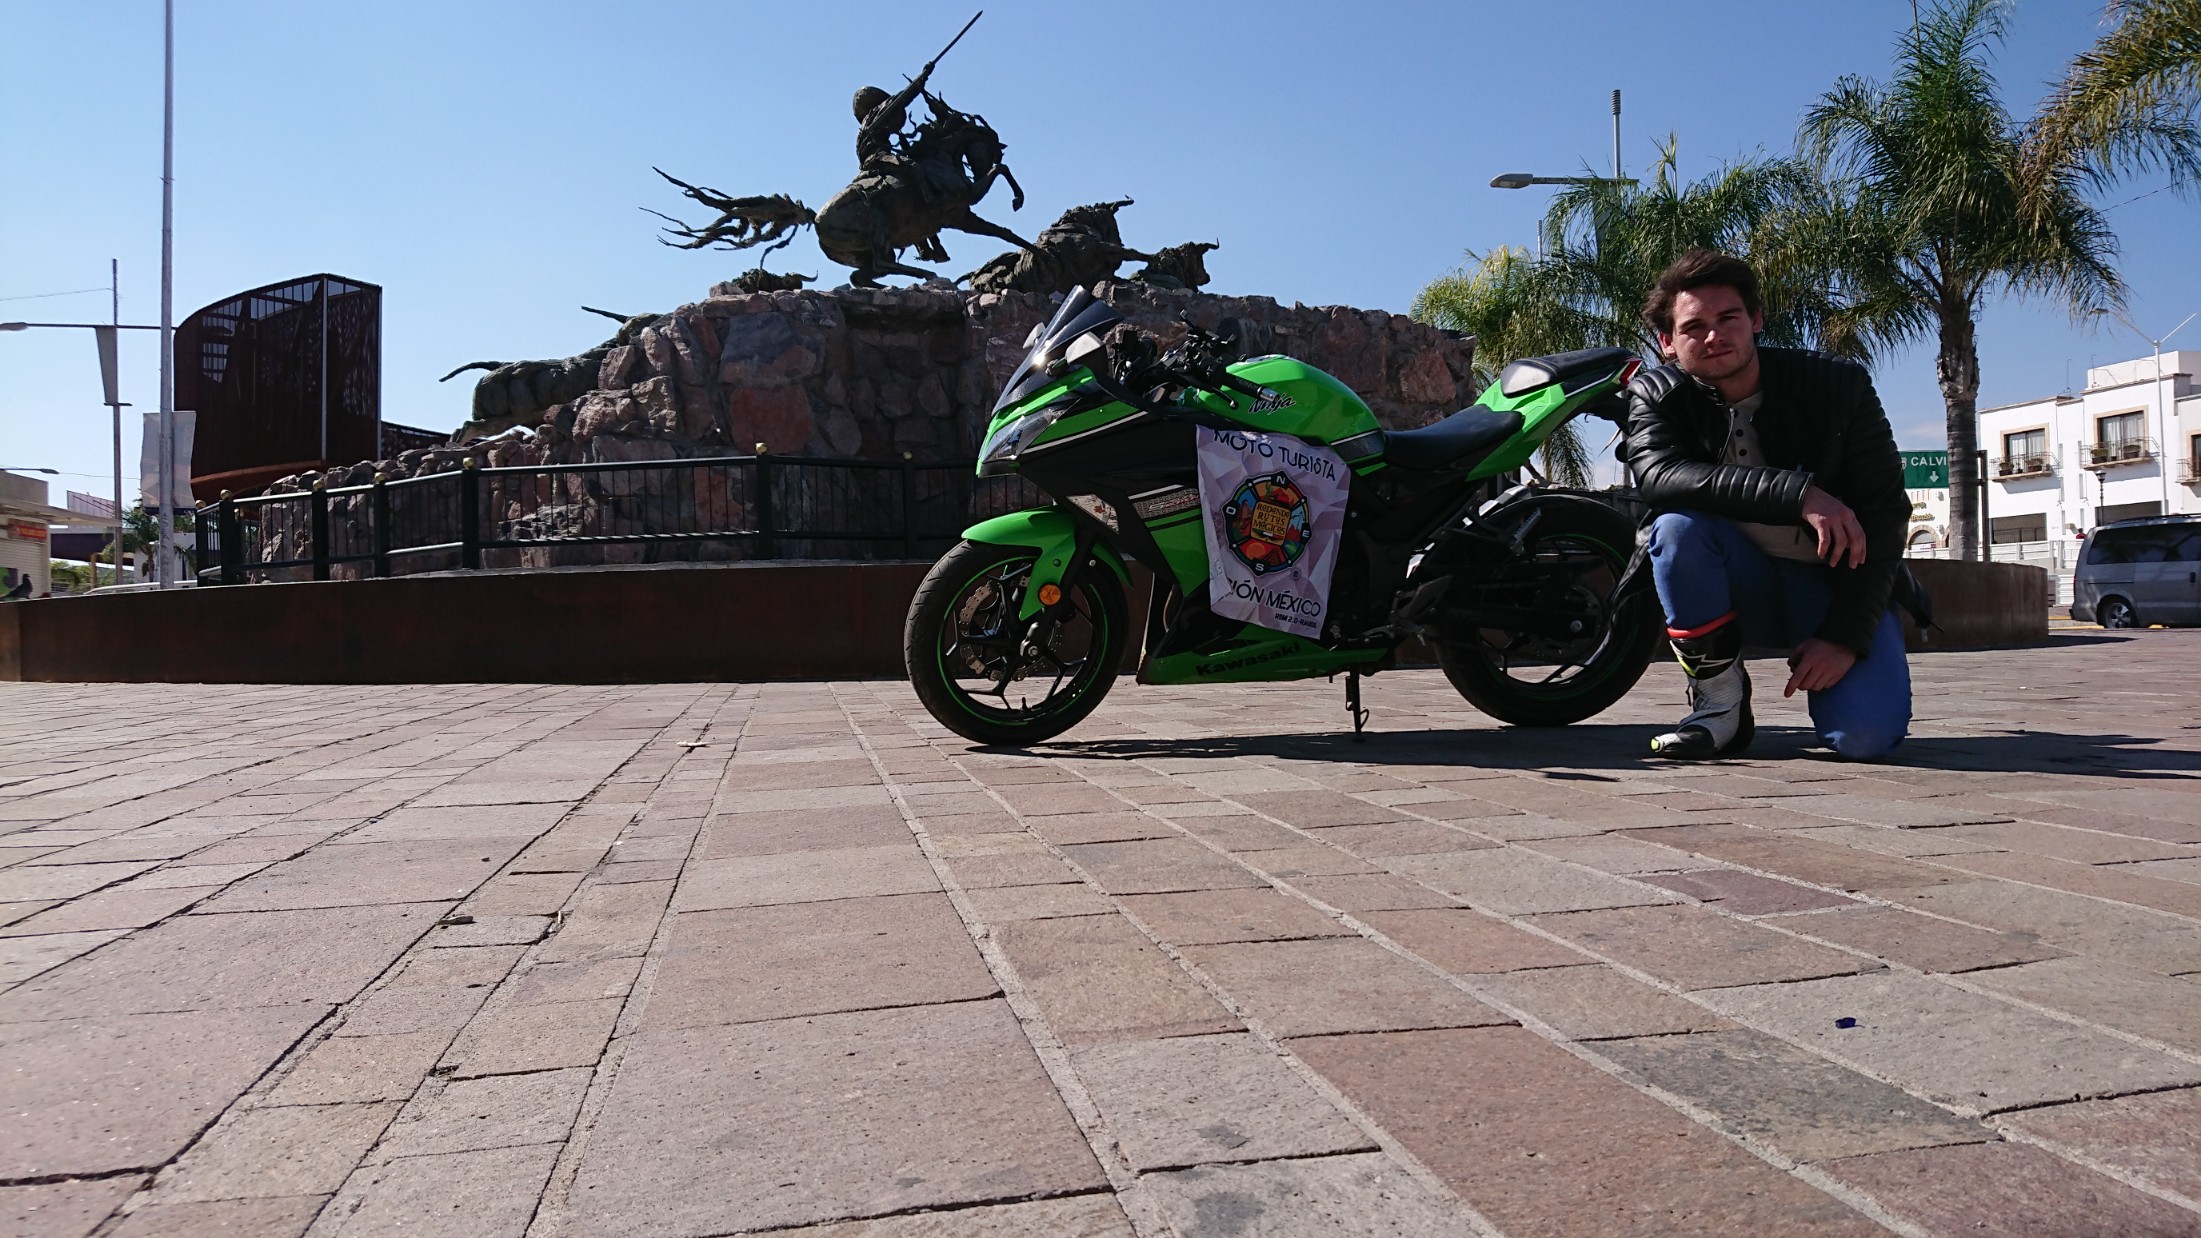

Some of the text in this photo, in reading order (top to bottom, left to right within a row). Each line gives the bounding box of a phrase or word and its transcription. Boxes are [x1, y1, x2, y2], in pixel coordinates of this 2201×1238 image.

[1248, 392, 1297, 416] Ninja
[1213, 429, 1336, 481] MOTO TURISTA
[1911, 456, 1947, 466] CALVI
[1276, 475, 1286, 485] N
[1302, 530, 1311, 538] E
[1255, 563, 1265, 572] S
[1227, 577, 1321, 617] IÓN MÉXICO
[1195, 641, 1300, 676] Kawasaki
